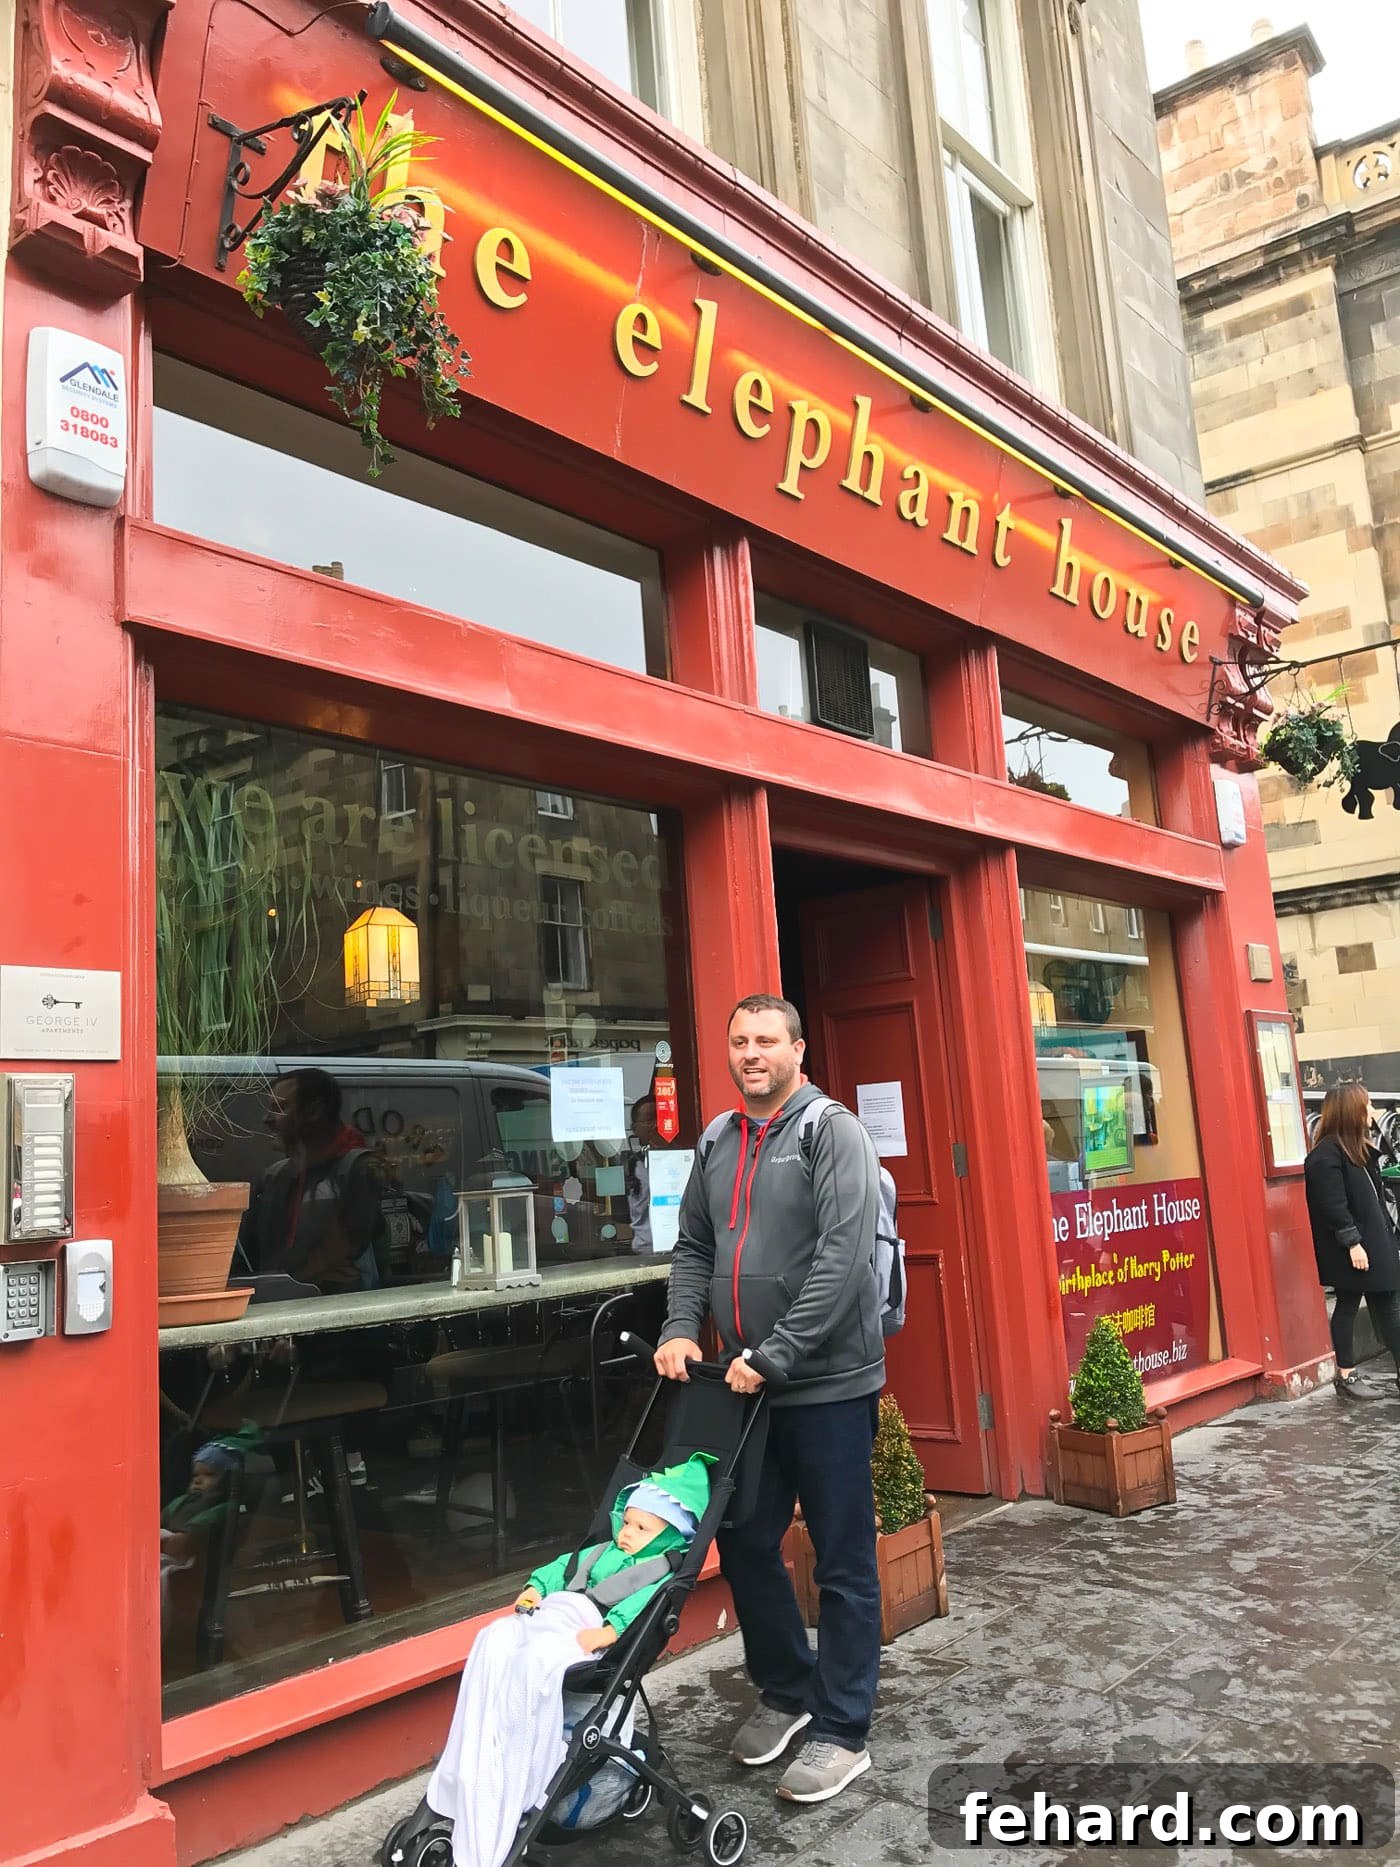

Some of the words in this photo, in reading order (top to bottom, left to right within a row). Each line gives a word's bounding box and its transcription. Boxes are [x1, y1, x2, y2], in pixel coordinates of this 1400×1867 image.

[69, 378, 119, 403] GLENDALE
[70, 406, 109, 429] 0800
[60, 419, 119, 449] 318083
[615, 298, 1016, 569] elephant
[1049, 517, 1200, 664] house
[301, 796, 416, 854] are
[26, 1015, 81, 1026] GEORGE
[86, 1017, 98, 1027] IV
[1074, 1198, 1149, 1241] Elephant
[1153, 1193, 1201, 1226] House
[1117, 1257, 1129, 1283] of
[1129, 1255, 1161, 1282] Harry
[1161, 1249, 1195, 1273] Potter
